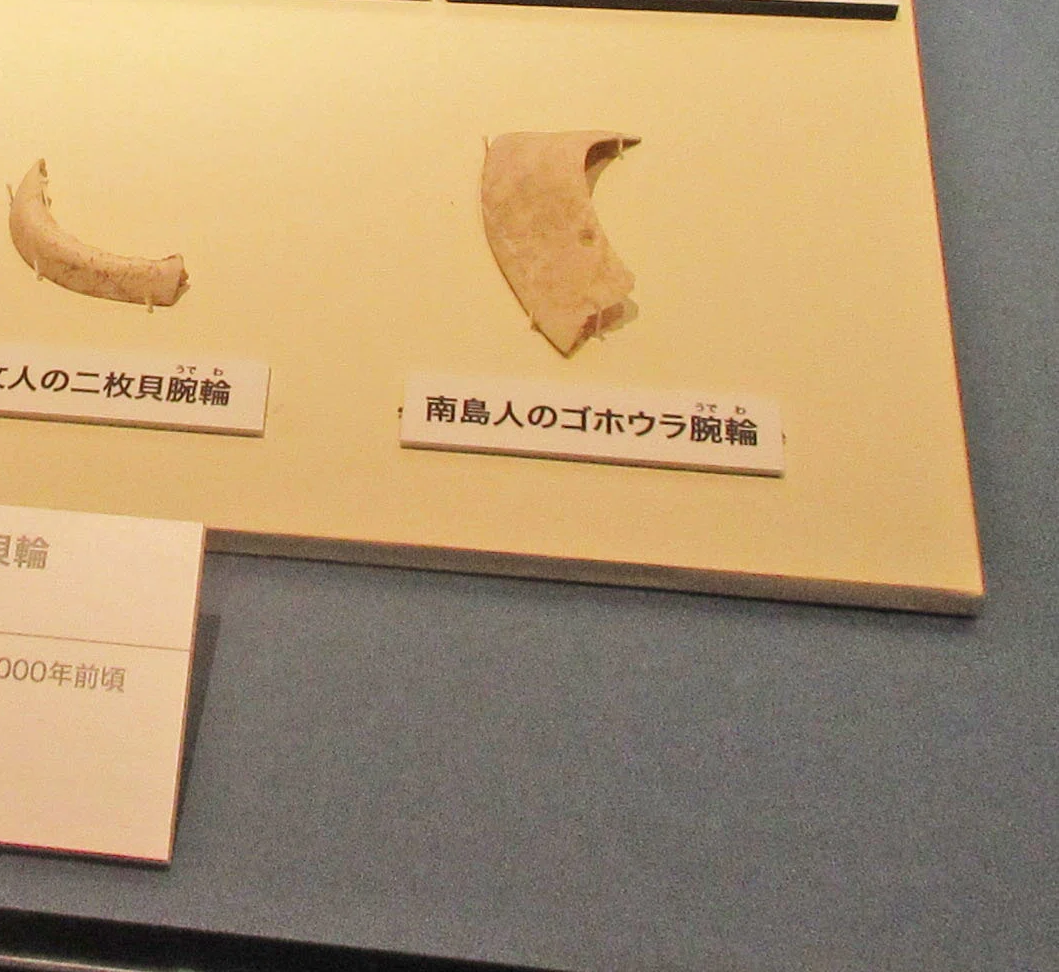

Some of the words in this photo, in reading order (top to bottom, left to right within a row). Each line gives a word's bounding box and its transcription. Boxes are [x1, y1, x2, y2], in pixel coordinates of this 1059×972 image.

[426, 395, 758, 447] 南島人のゴホウラ腕輪
